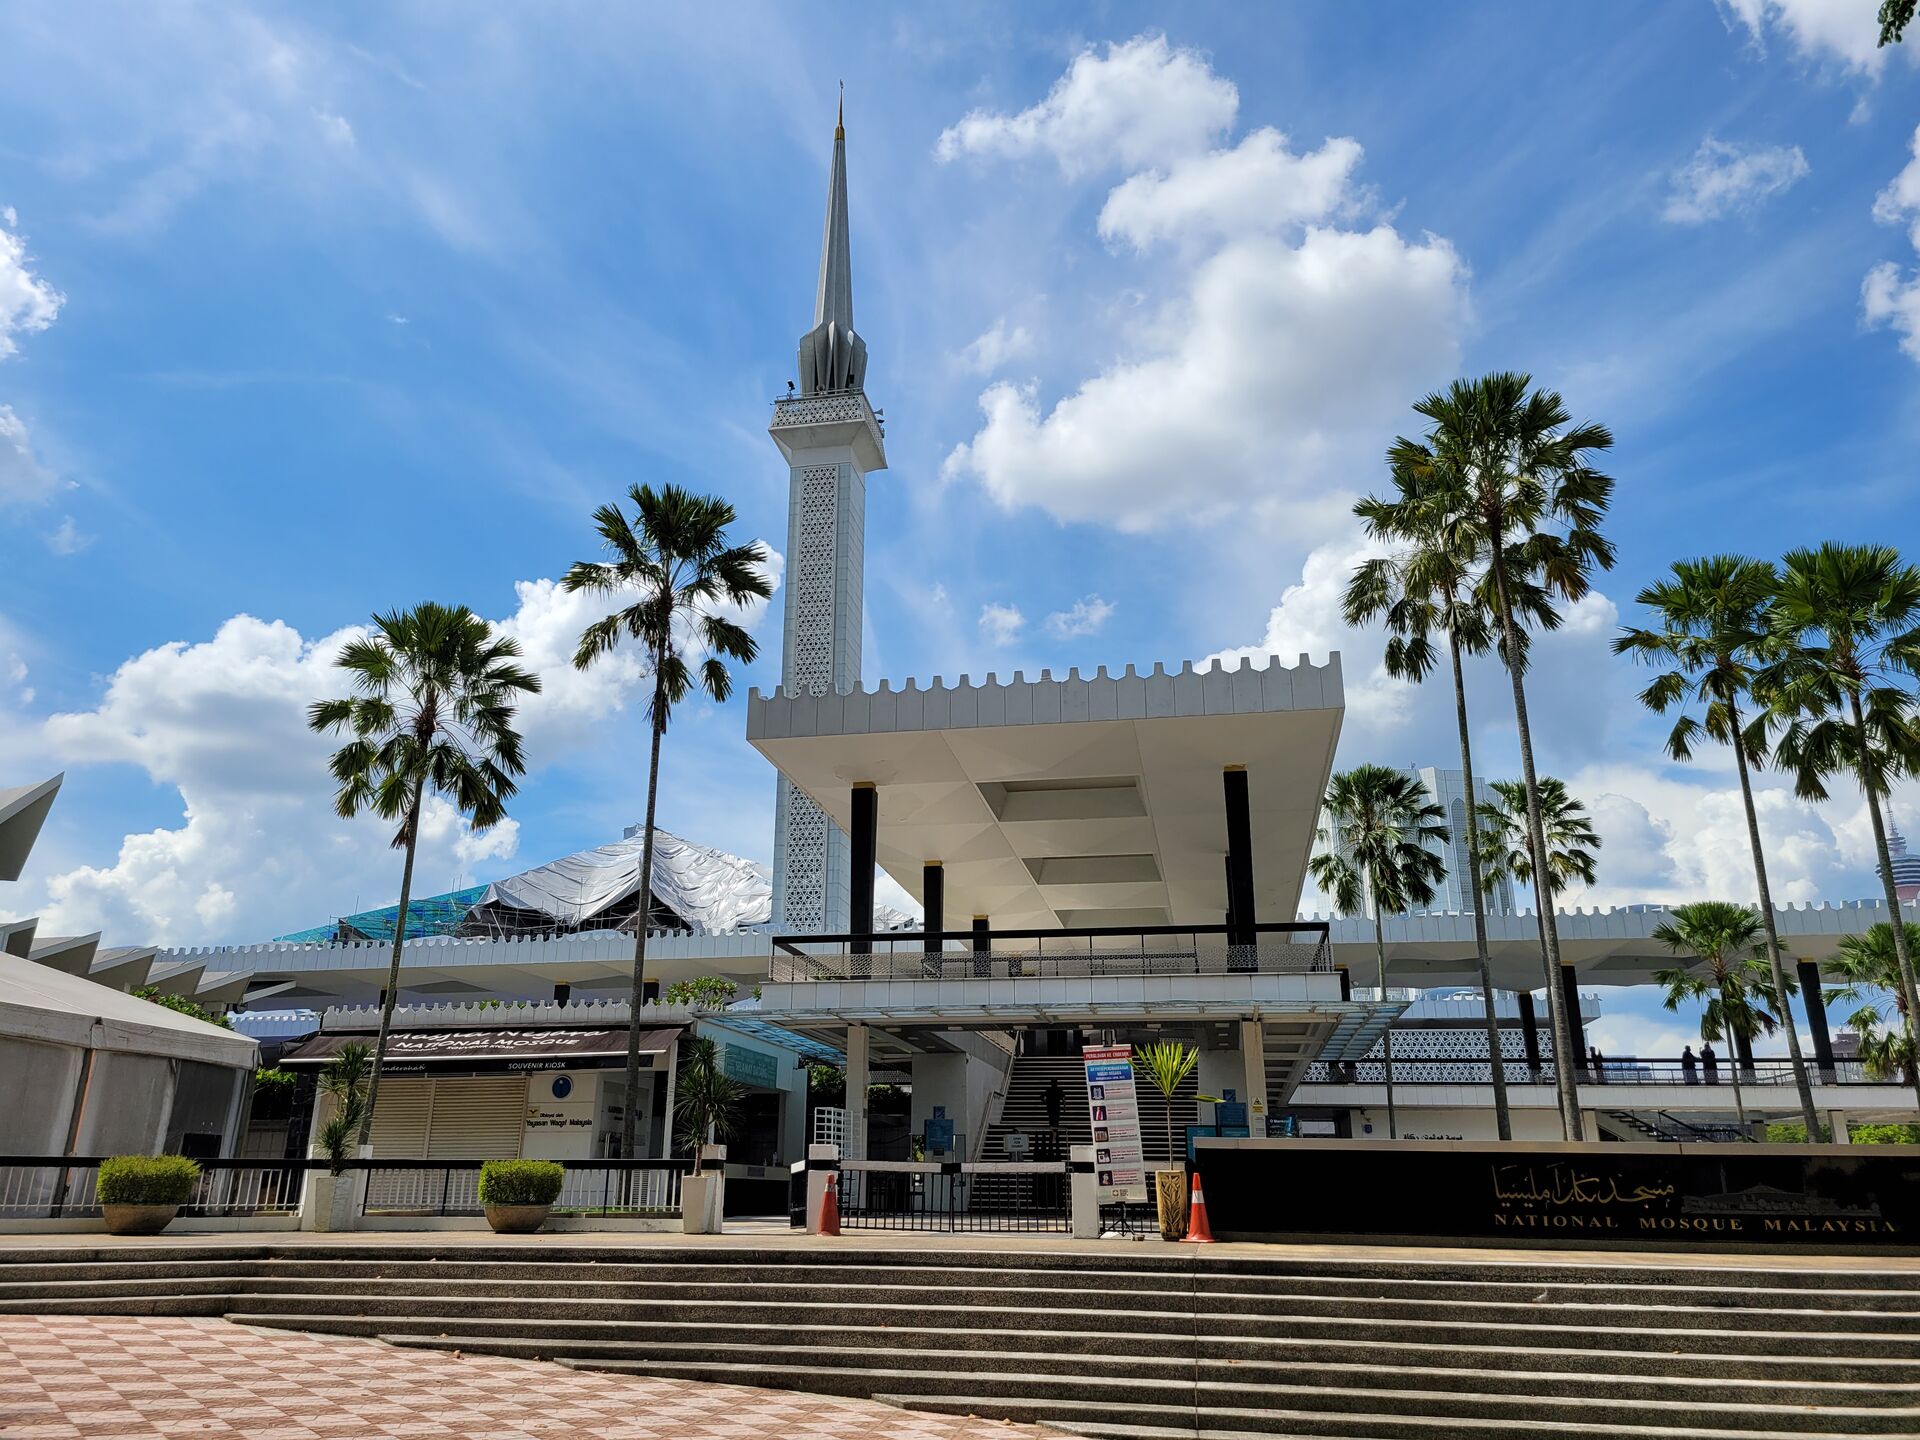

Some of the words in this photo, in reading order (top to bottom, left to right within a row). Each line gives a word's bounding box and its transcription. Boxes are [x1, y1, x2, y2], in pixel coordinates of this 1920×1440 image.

[395, 1039, 490, 1049] NATIONAL
[527, 1120, 549, 1128] Yayasan
[569, 1119, 593, 1127] Malaysia
[1493, 1212, 1620, 1228] NATIONAL
[1639, 1217, 1744, 1231] MOSQUE
[1763, 1218, 1897, 1233] MALAYSIA
